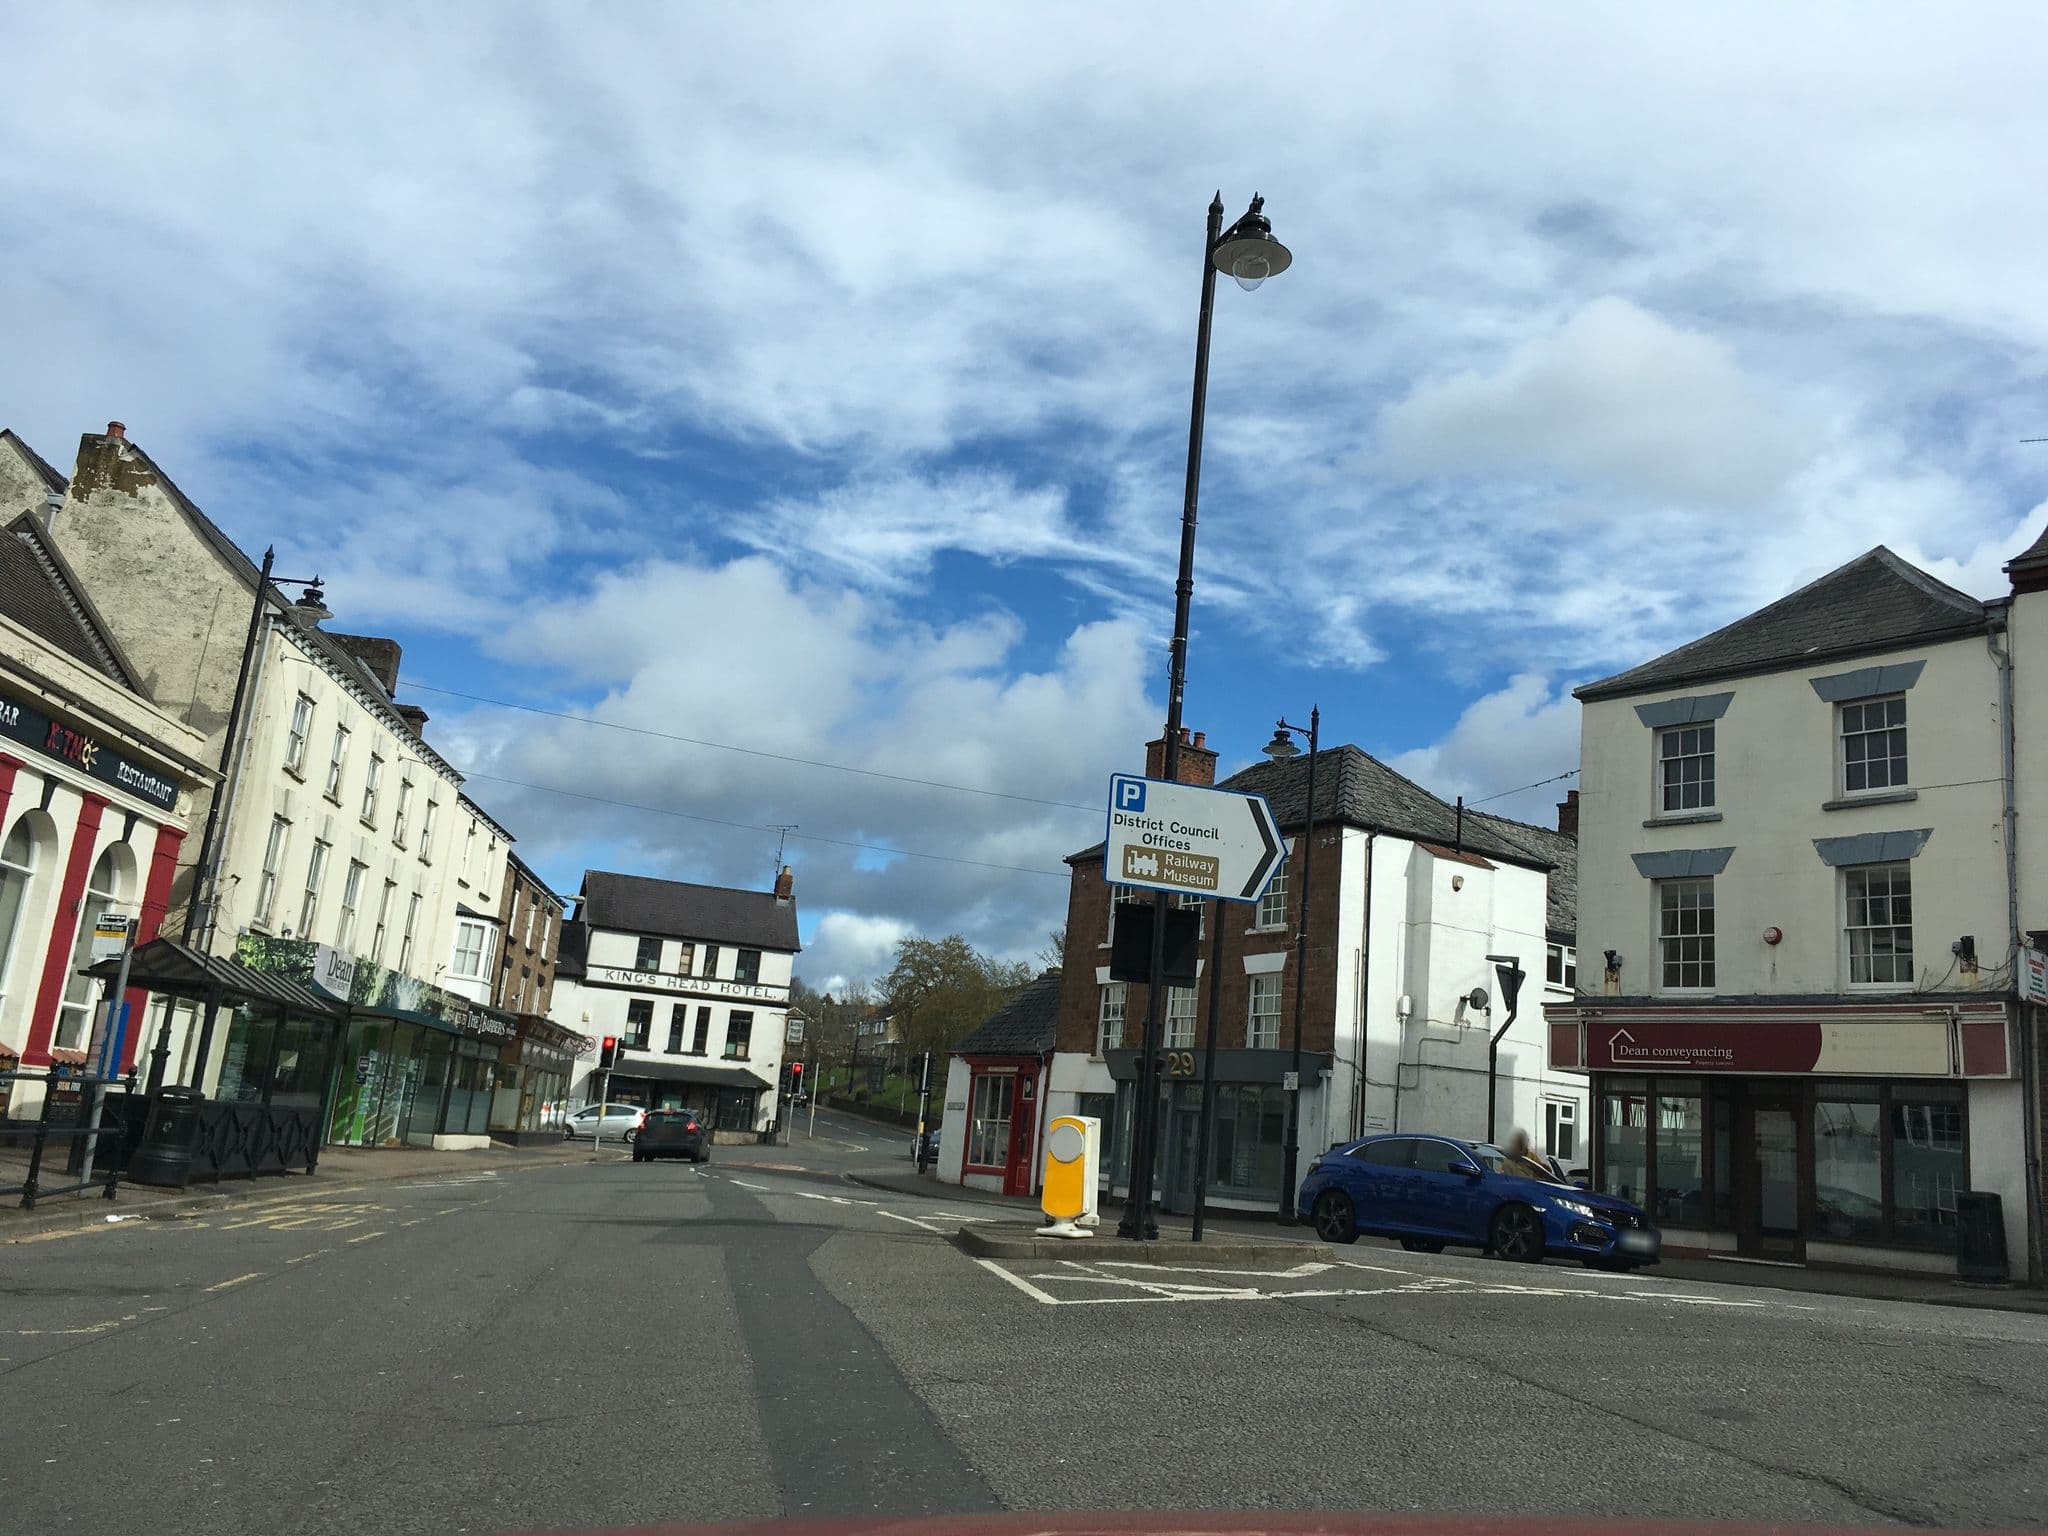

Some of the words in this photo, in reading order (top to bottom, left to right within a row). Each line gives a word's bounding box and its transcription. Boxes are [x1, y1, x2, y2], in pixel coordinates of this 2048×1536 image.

[116, 761, 173, 803] RESTAURANT
[1122, 783, 1141, 807] P
[1113, 813, 1164, 832] District
[1170, 821, 1220, 840] Council
[1142, 833, 1191, 851] Offices
[1164, 854, 1214, 872] Railway
[1162, 868, 1215, 887] Museum
[327, 950, 353, 983] Dean
[604, 969, 657, 985] KING'S
[667, 976, 711, 992] HEAD
[1168, 1051, 1197, 1077] 29
[1619, 1045, 1649, 1056] Dean
[1652, 1046, 1734, 1060] conveyancing
